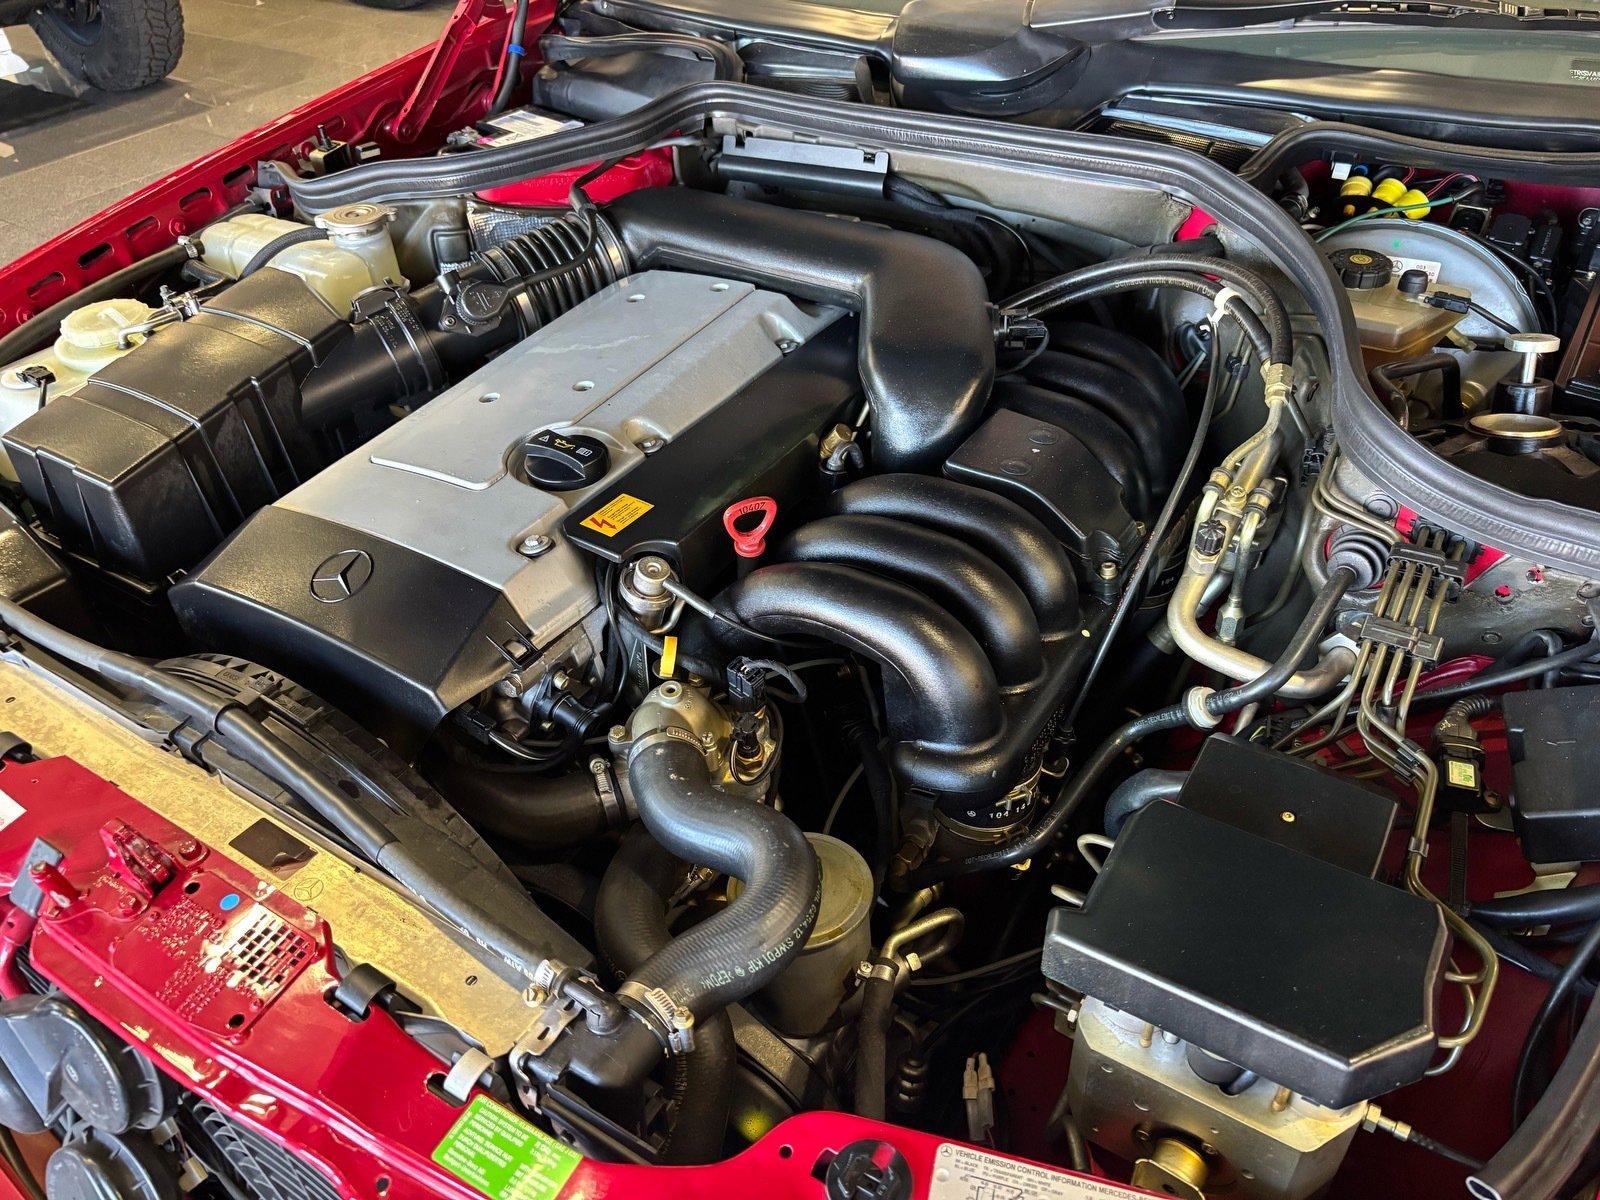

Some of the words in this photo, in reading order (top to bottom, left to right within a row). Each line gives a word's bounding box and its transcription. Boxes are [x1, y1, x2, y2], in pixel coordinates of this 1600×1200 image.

[738, 502, 766, 515] 10407
[989, 810, 1009, 819] 104
[763, 940, 794, 965] SWP01
[954, 1149, 983, 1162] VEHICLE
[983, 1156, 1016, 1170] EMISSION
[1016, 1165, 1050, 1179] CONTROL
[1050, 1174, 1097, 1190] INFORMATION
